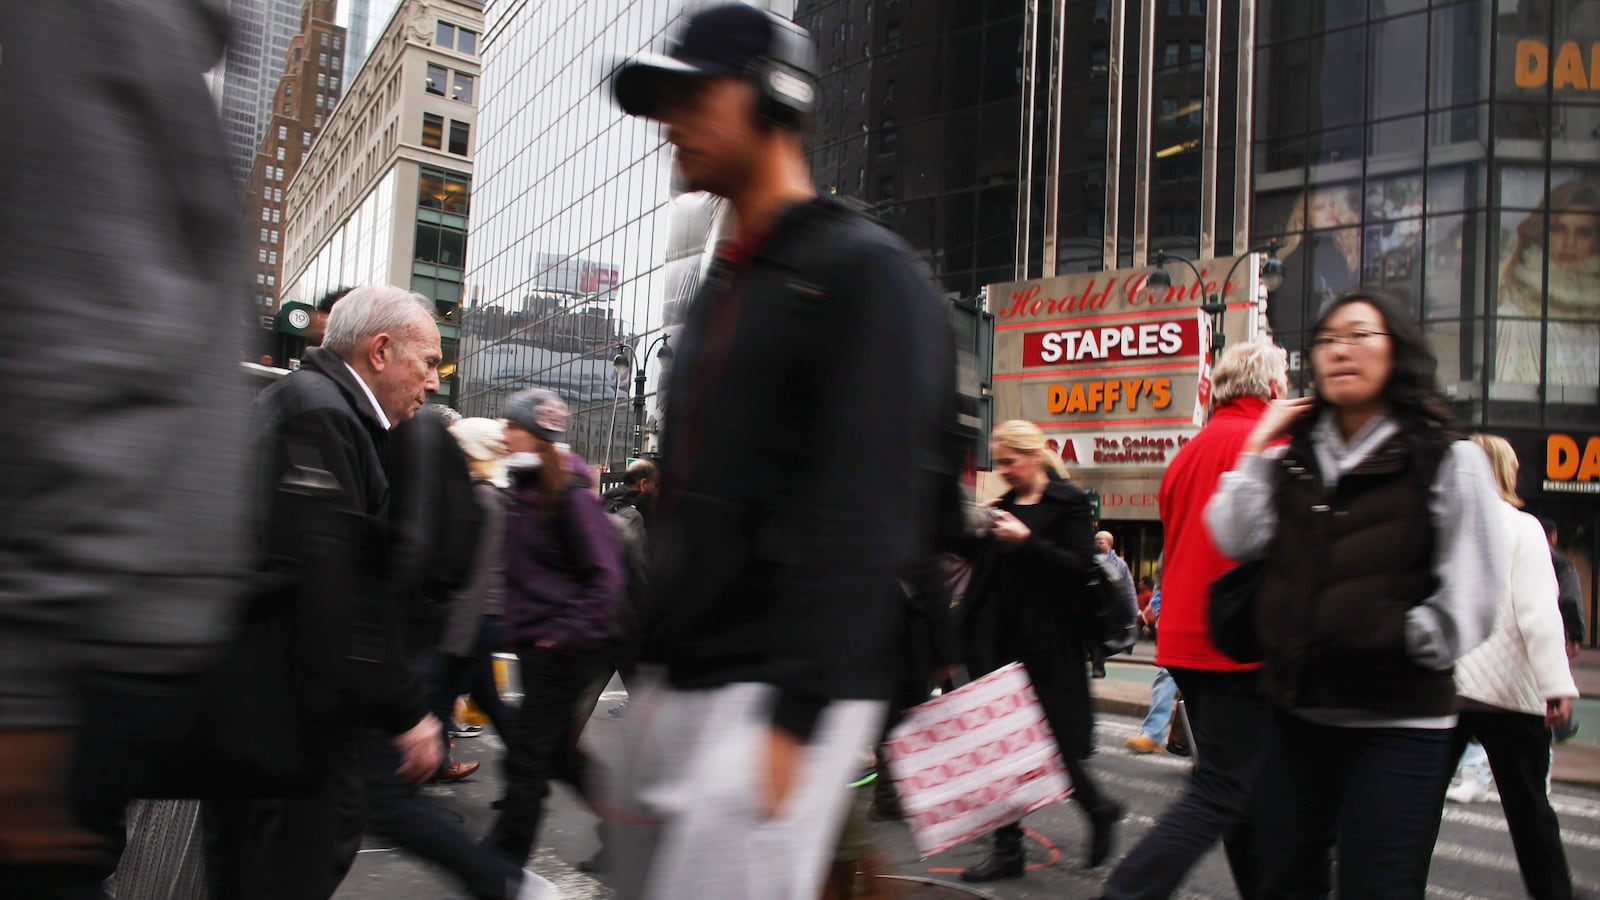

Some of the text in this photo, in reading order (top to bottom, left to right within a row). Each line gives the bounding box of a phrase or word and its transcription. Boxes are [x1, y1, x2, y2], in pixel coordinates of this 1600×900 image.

[1000, 276, 1117, 319] Herald
[1040, 321, 1183, 363] STAPLES
[1047, 377, 1172, 413] DAFFY'S
[1094, 437, 1118, 449] The
[1122, 435, 1174, 450] College
[1093, 449, 1166, 463] Excellence
[1101, 493, 1125, 507] LD
